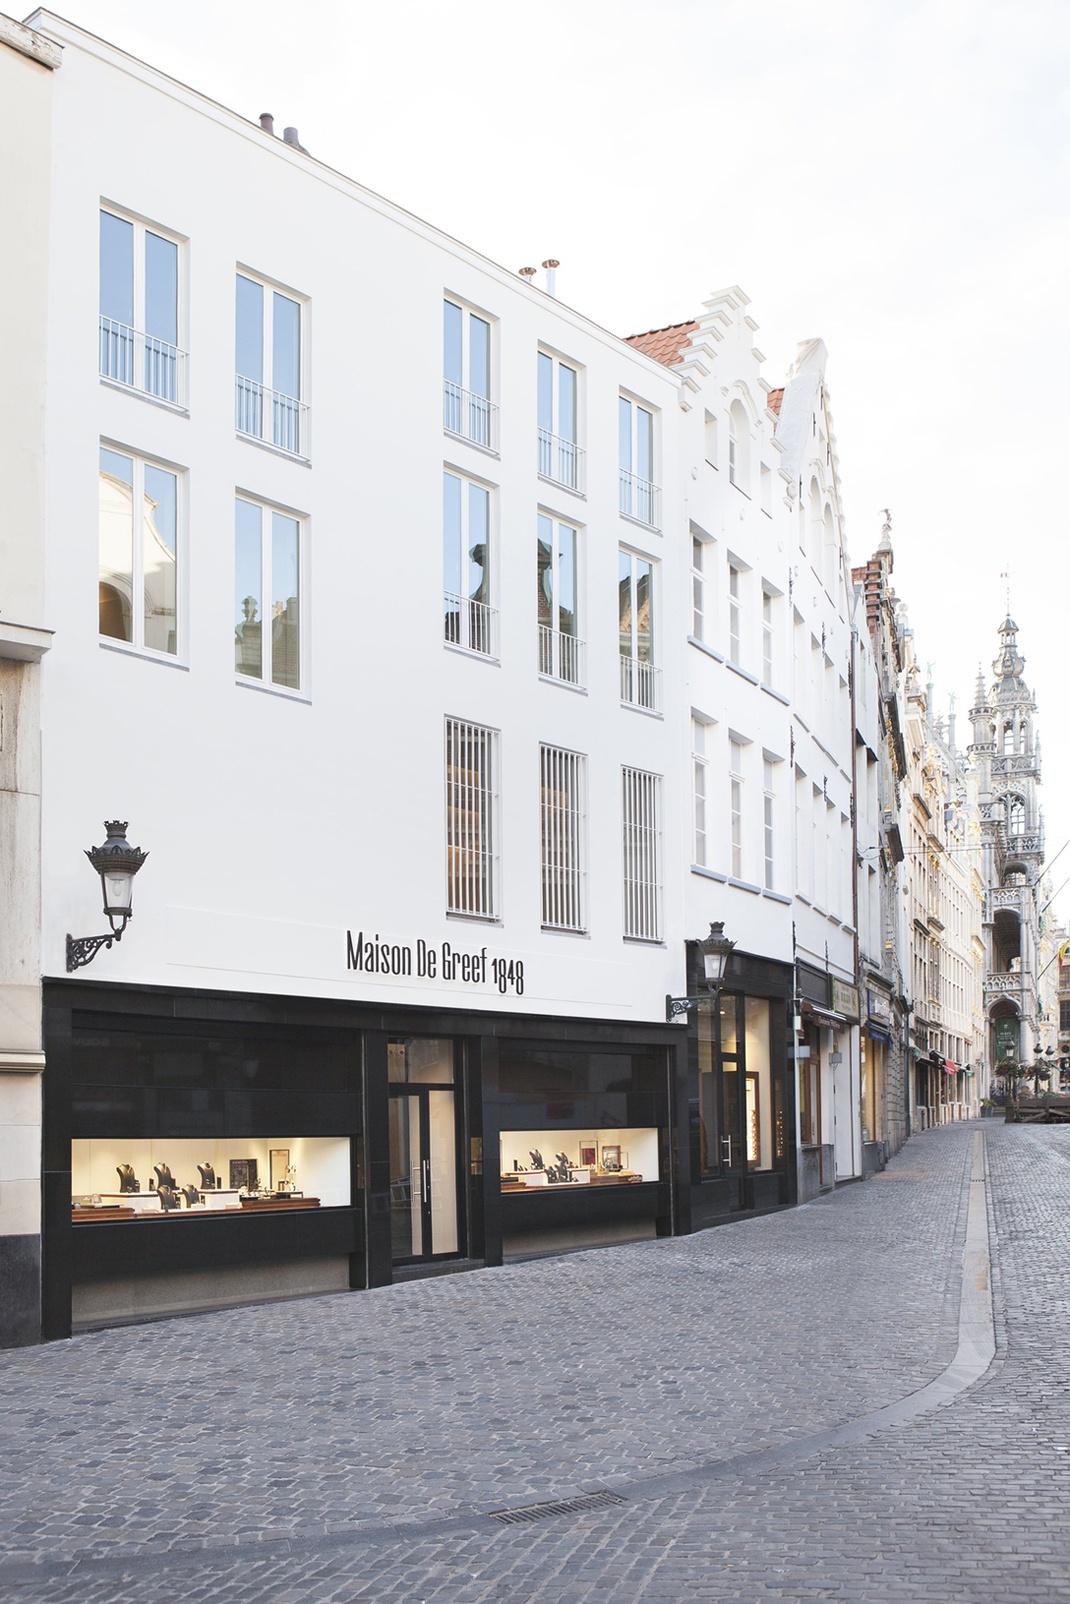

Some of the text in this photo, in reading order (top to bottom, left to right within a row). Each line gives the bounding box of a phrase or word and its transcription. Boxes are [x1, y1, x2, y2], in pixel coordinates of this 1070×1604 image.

[347, 930, 524, 995] Maison De Greef 1848
